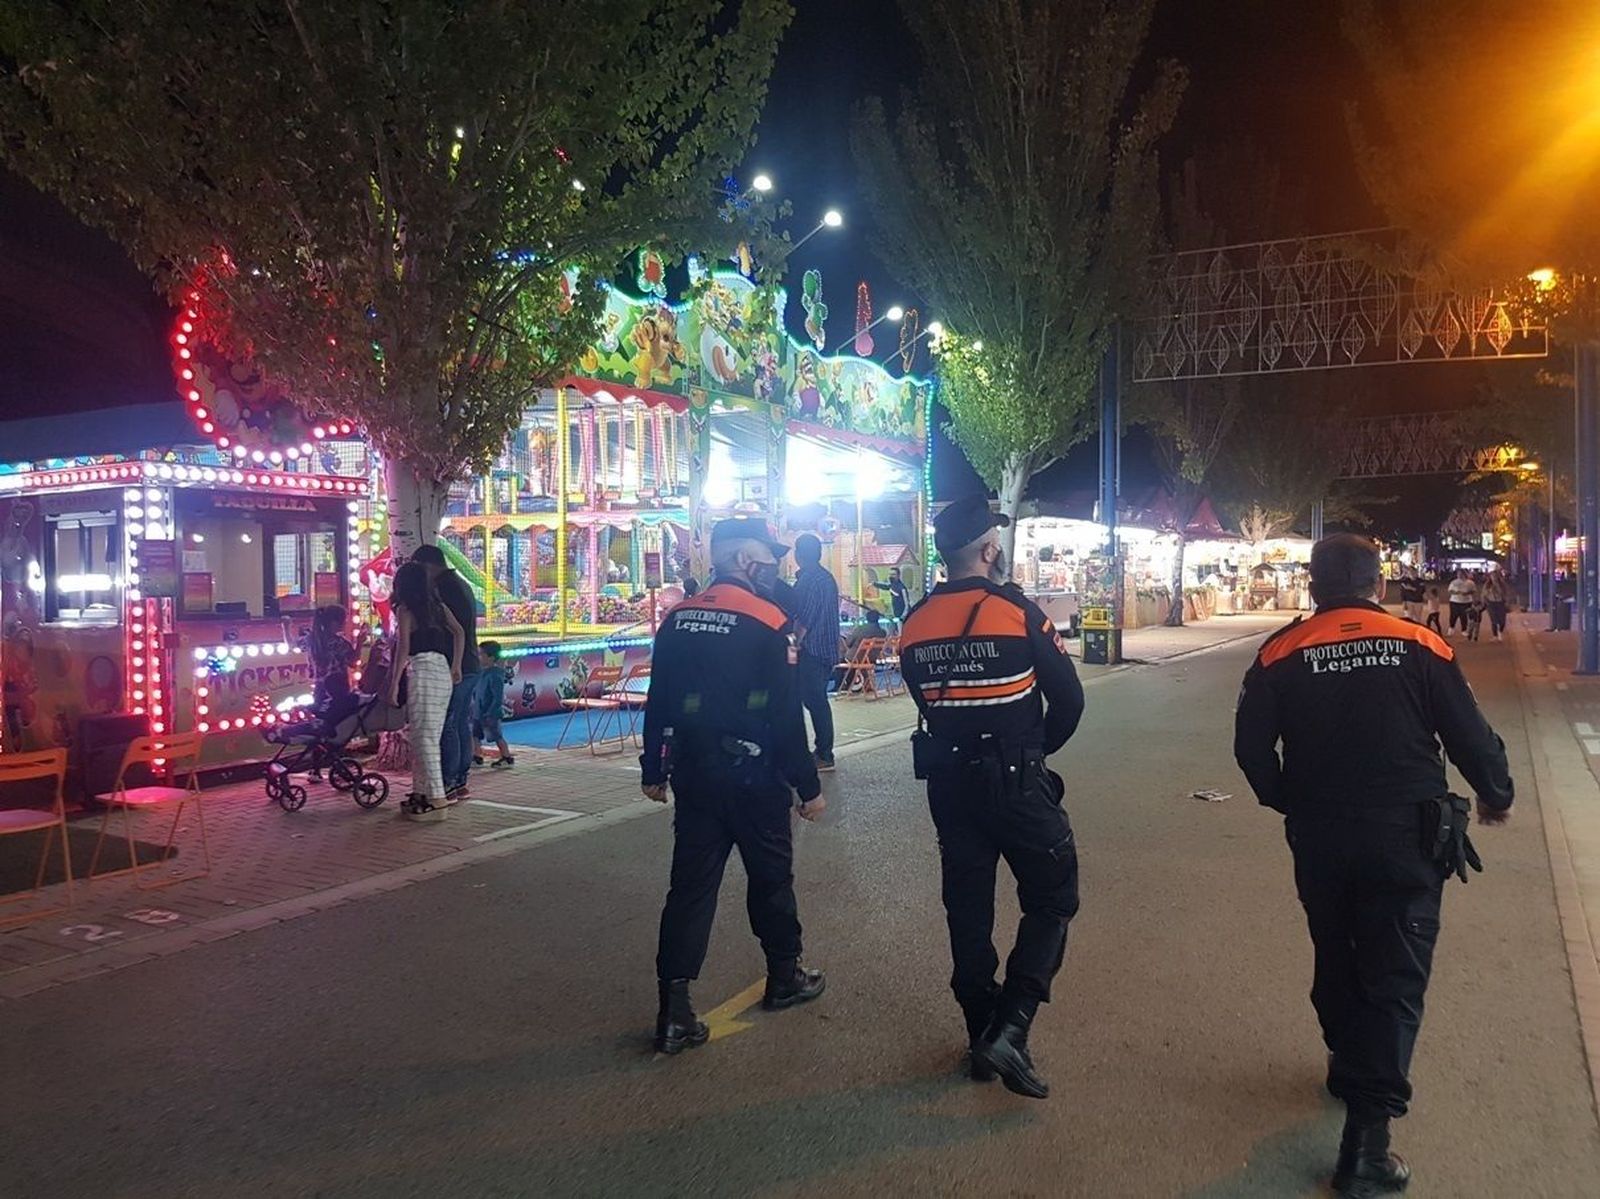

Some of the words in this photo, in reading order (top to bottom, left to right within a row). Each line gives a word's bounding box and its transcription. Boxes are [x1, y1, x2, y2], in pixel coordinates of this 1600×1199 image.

[675, 620, 731, 634] Leganés
[717, 611, 738, 626] CIVIL
[914, 643, 968, 665] PROTECCIN
[969, 641, 1000, 659] CIVIL
[1303, 640, 1374, 663] PROTECCION
[1375, 639, 1408, 655] CIVIL
[1312, 649, 1401, 673] Leganés
